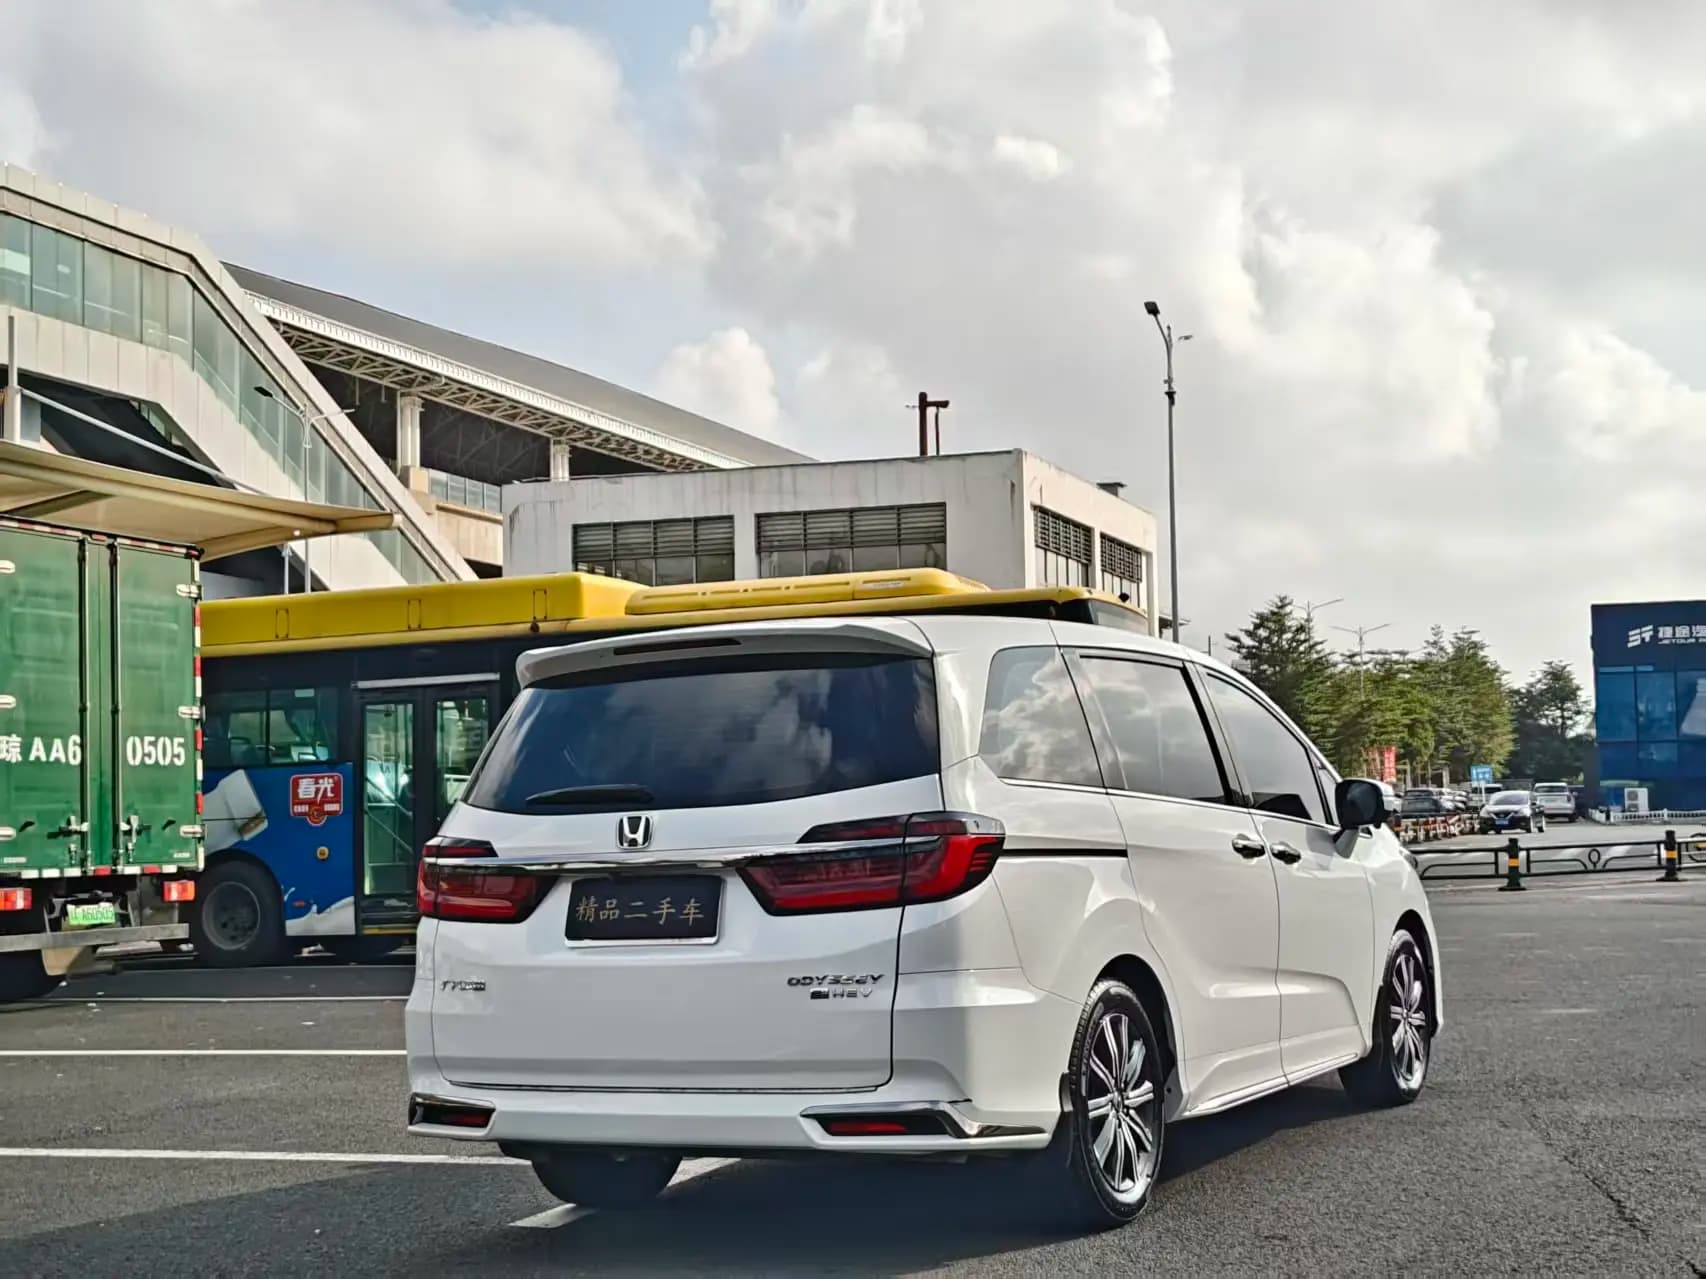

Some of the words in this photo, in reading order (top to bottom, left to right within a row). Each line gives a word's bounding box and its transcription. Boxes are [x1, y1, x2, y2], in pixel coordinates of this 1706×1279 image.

[126, 735, 186, 766] 0505
[298, 777, 335, 804] 春光
[576, 895, 705, 926] 精品二手车
[786, 974, 885, 987] ODYSSEY
